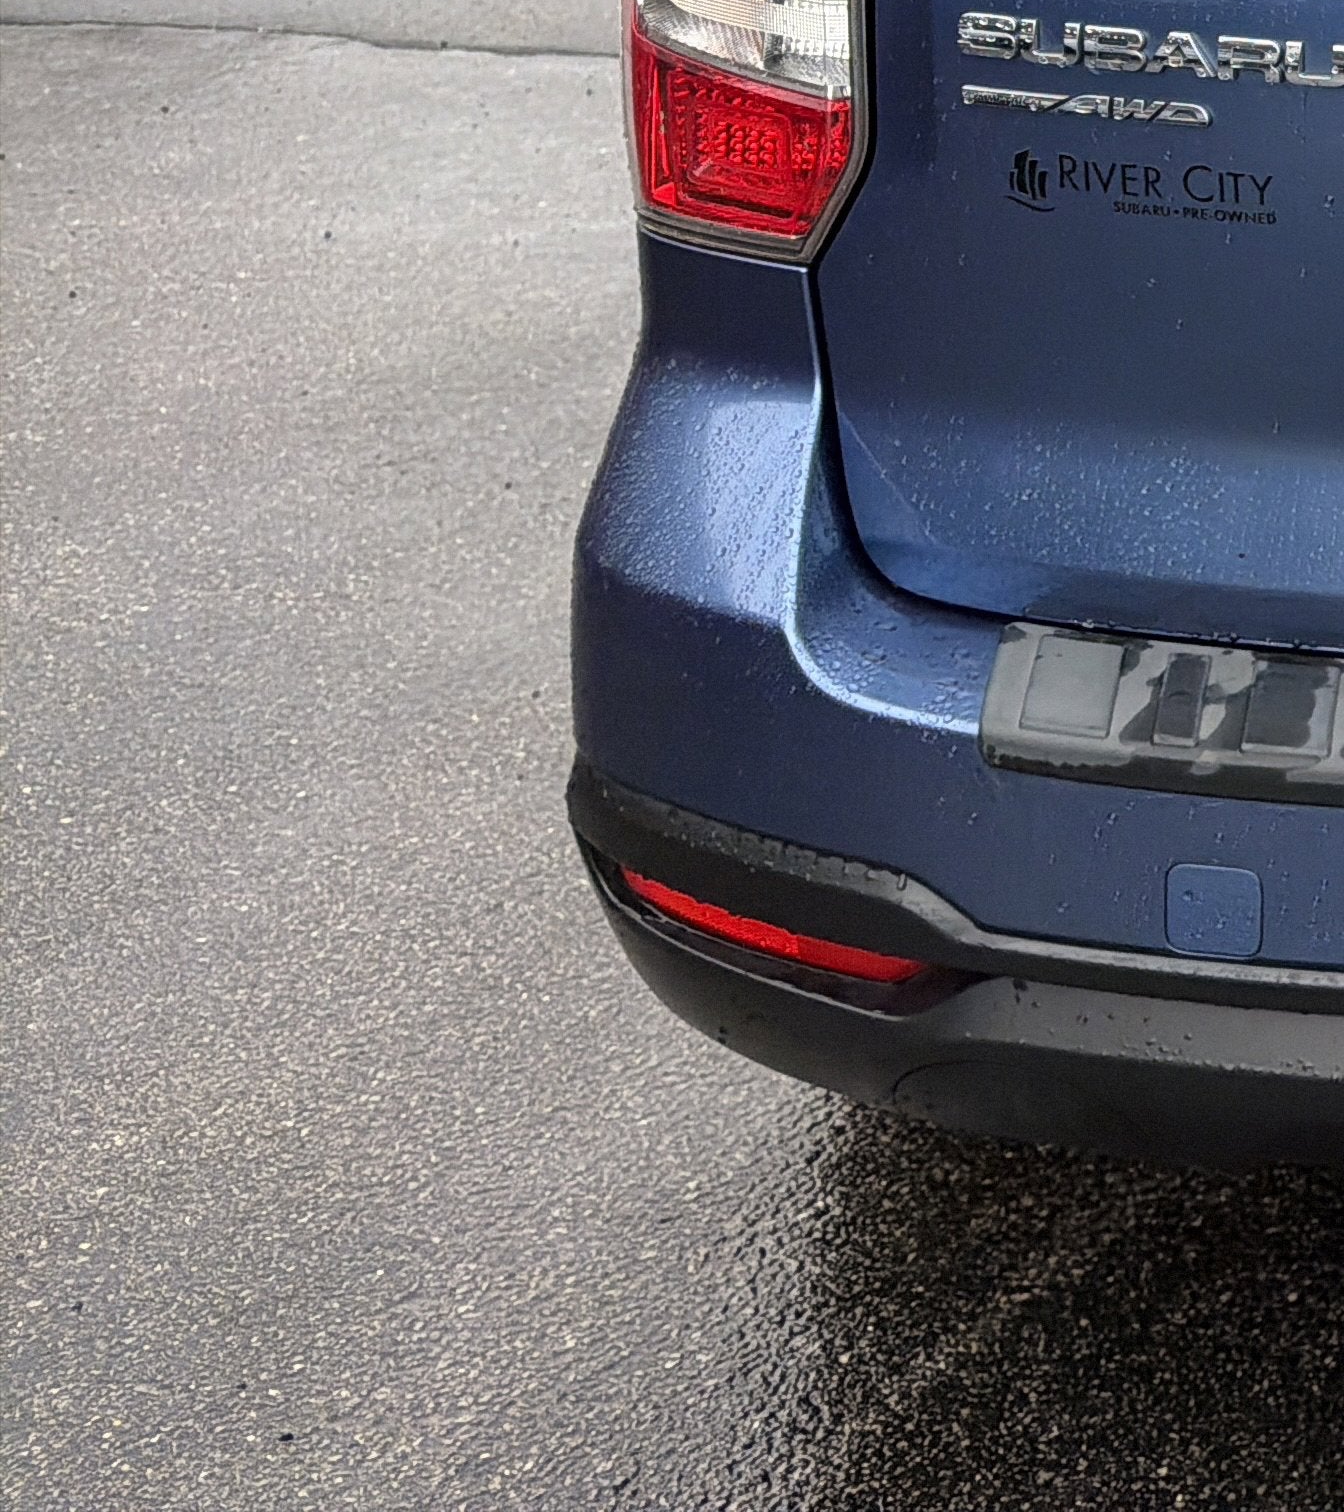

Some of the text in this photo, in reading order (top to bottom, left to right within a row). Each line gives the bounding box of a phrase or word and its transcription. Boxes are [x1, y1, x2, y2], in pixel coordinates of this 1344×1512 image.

[1043, 94, 1214, 128] AWD
[1058, 153, 1273, 206] RIVER CITY
[1113, 201, 1277, 225] SUBARU PRE-OWNED
